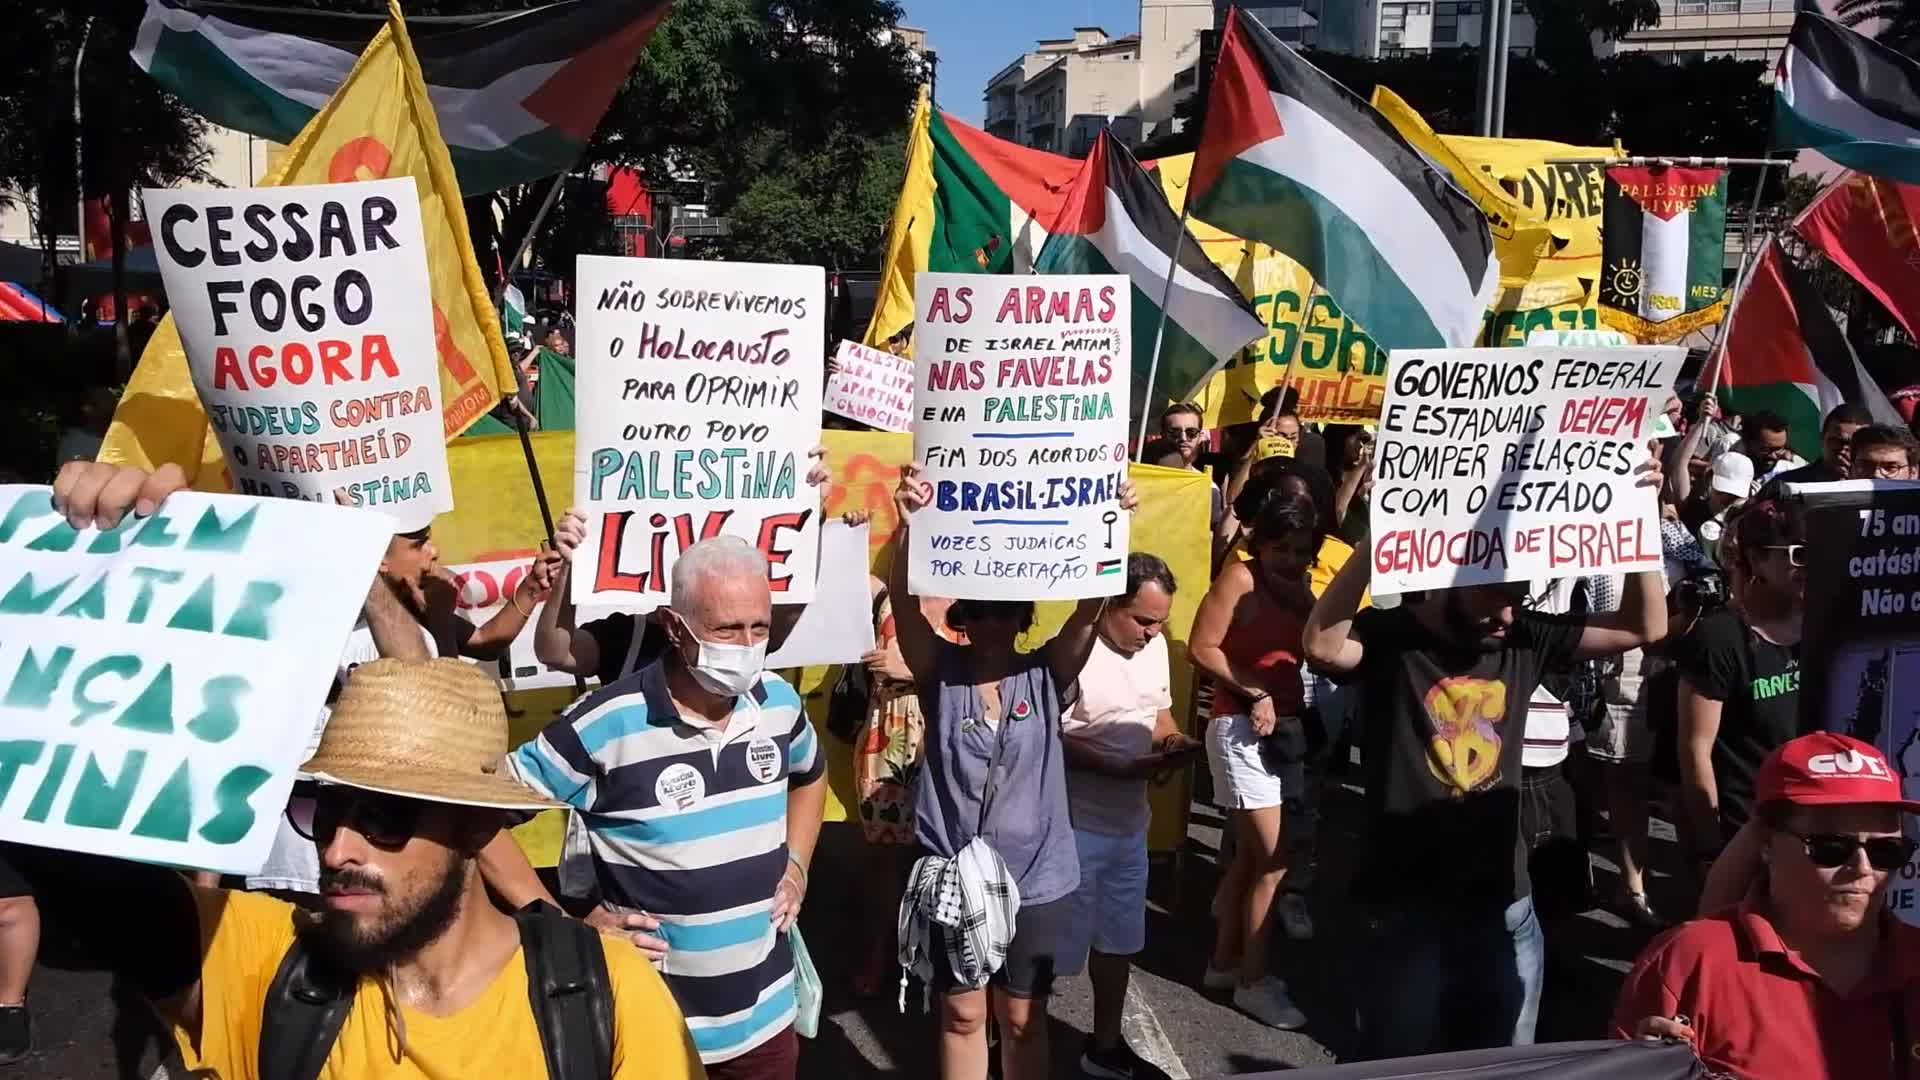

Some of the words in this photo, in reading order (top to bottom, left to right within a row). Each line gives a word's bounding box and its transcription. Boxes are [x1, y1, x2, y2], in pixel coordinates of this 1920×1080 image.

[1619, 182, 1718, 198] PALESTINA
[1640, 200, 1698, 213] LIVRE
[161, 196, 401, 268] CESSAR
[206, 269, 373, 336] FOGO
[597, 280, 645, 313] NÃO
[926, 286, 974, 324] AS
[995, 285, 1117, 324] ARMAS
[1691, 285, 1718, 298] MES
[609, 337, 625, 358] O
[945, 337, 973, 353] DE
[985, 337, 1057, 352] ISRAEL
[1062, 336, 1111, 352] MATAM
[213, 334, 400, 391] AGORA
[927, 359, 985, 392] NAS
[996, 354, 1113, 389] FAVELAS
[621, 378, 676, 402] PARA
[1394, 359, 1544, 400] GOVERNOS
[1550, 357, 1663, 390] FEDERAL
[211, 401, 321, 435] JUDEUS
[329, 386, 432, 428] CONTRA
[922, 406, 936, 421] E
[940, 406, 966, 423] NA
[1385, 404, 1407, 432] E
[1412, 403, 1547, 441] ESTADUAIS
[1559, 396, 1648, 439] DEVEM
[622, 423, 692, 443] OUTRO
[706, 420, 770, 443] POVO
[233, 446, 248, 467] O
[978, 447, 1018, 467] DOS
[1028, 444, 1108, 466] ACORDOS
[1378, 440, 1489, 481] ROMPER
[1502, 438, 1634, 476] RELAÇÕES
[1380, 487, 1448, 517] COM
[1467, 485, 1488, 514] O
[1496, 480, 1613, 514] ESTADO
[1858, 509, 1886, 537] 75
[930, 535, 992, 552] VOZES
[1374, 526, 1510, 574] GENOCIDA
[1514, 528, 1545, 553] DE
[1550, 518, 1661, 568] ISRAEL
[930, 558, 966, 577] POR
[0, 566, 286, 641] MATAR
[1860, 587, 1905, 617] Não
[1808, 749, 1886, 775] CUT
